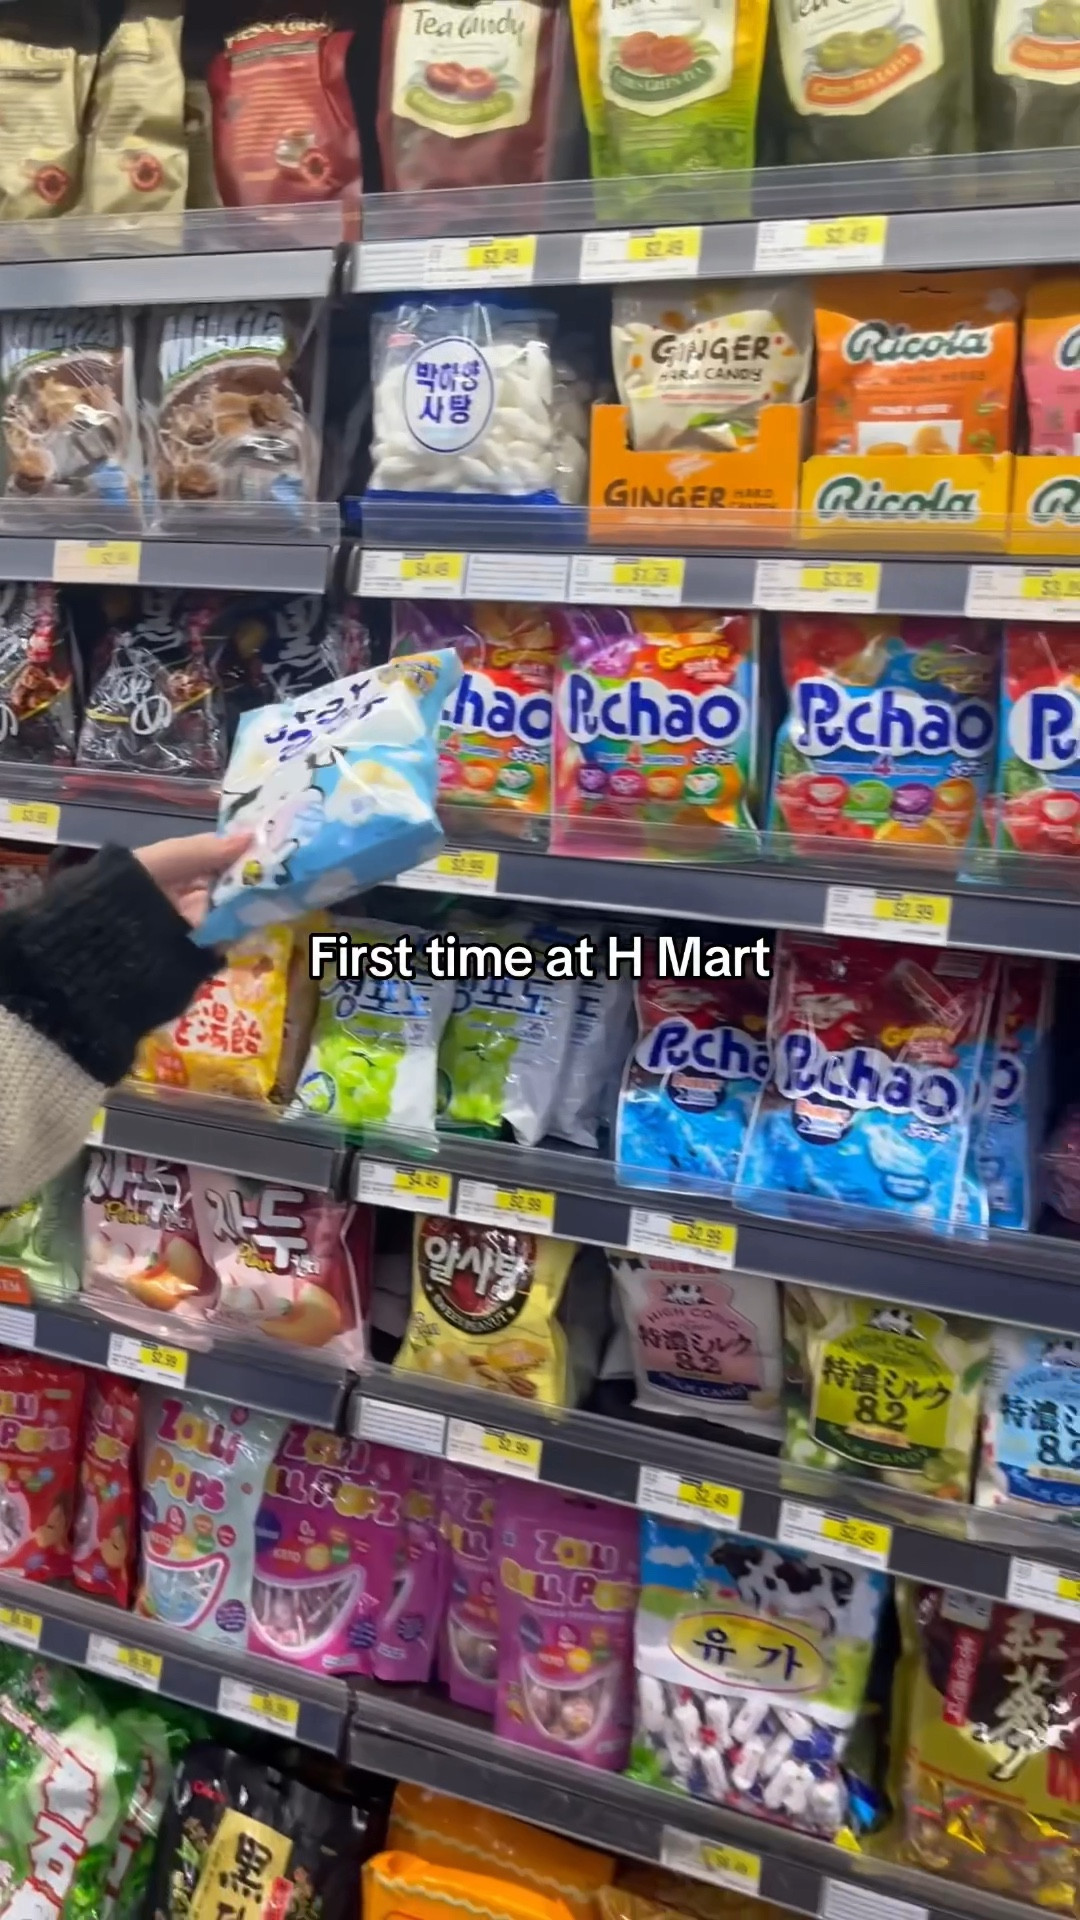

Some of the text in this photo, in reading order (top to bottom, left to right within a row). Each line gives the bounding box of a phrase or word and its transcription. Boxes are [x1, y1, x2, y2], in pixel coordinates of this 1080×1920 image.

[413, 8, 453, 37] Tea
[651, 334, 770, 364] GINGER
[846, 321, 988, 362] Ricola
[704, 367, 762, 382] CANDY
[418, 394, 472, 424] 사탕
[603, 478, 726, 508] GINGER
[817, 475, 977, 520] Ricola
[569, 673, 741, 740] Puchao
[797, 682, 994, 750] Puchao
[783, 1034, 959, 1118] Puchao
[423, 1231, 529, 1301] 알사탕
[638, 1324, 752, 1357] 特濃ミルク
[822, 1355, 951, 1411] 特濃ミルク
